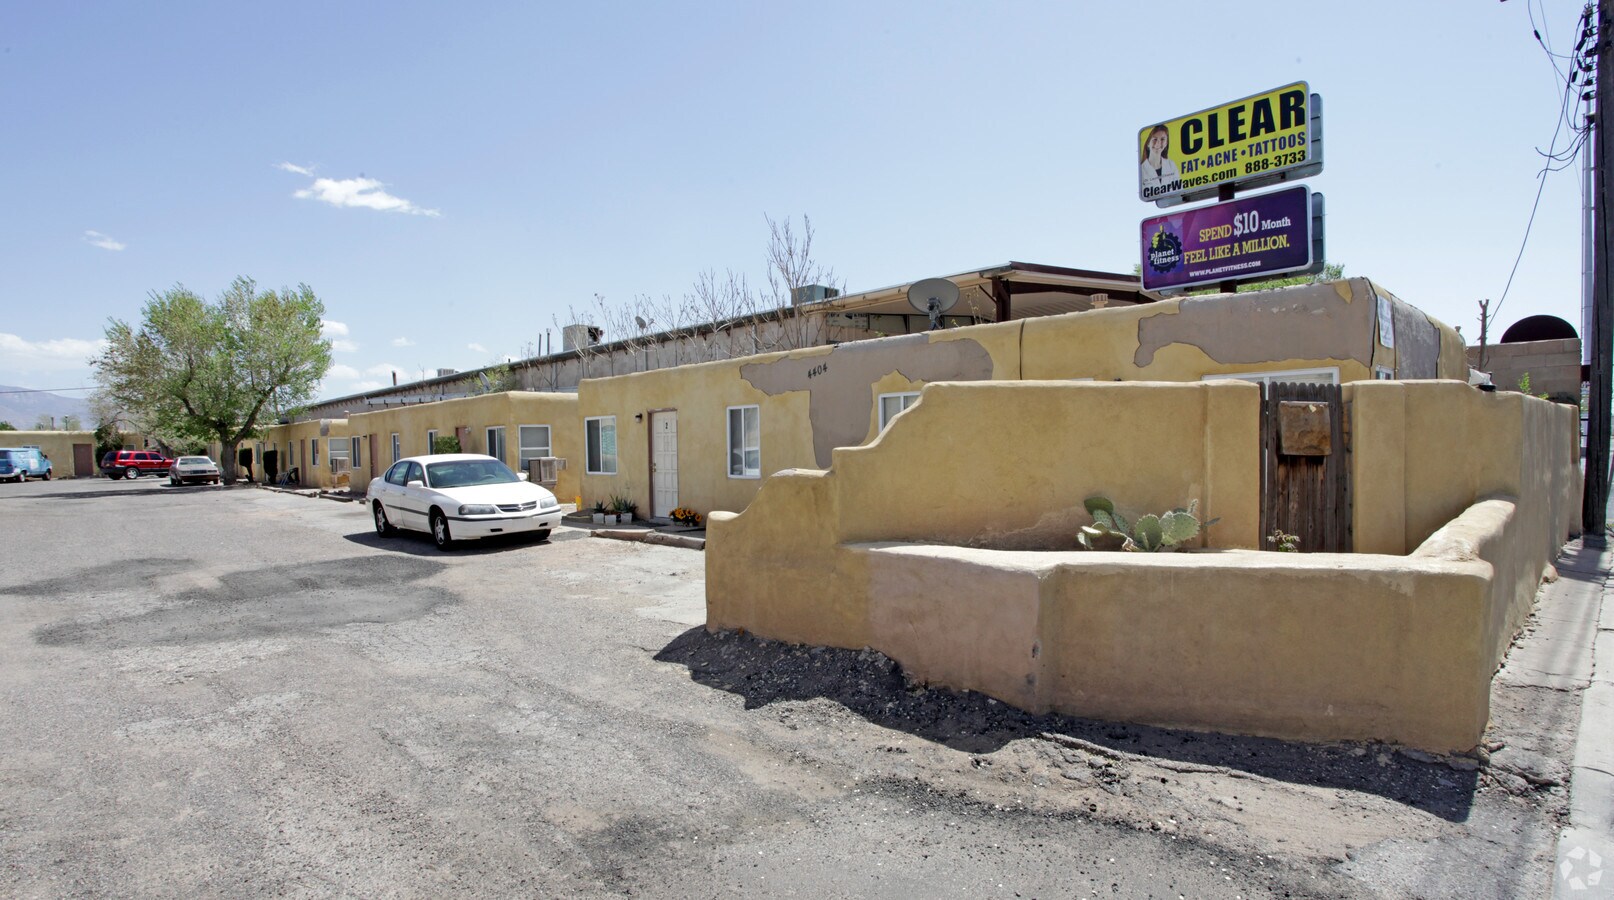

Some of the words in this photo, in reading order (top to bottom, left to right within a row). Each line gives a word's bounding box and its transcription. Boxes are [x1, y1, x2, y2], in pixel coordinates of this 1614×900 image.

[1180, 89, 1306, 156] CLEAR
[1143, 167, 1237, 198] ClearWaves.com
[1245, 150, 1306, 174] 888-3733
[1199, 224, 1232, 242] SPEND
[1233, 210, 1259, 237] $10
[1261, 216, 1291, 231] Month
[1150, 248, 1174, 261] planet
[1184, 249, 1207, 264] FEEL
[1209, 245, 1231, 260] LIKE
[1232, 244, 1240, 256] A
[1241, 234, 1290, 255] MILLION.
[1153, 255, 1179, 265] fitness
[1189, 260, 1261, 277] WWW.PLANETFITNESS.COM
[807, 362, 828, 379] 4404
[665, 422, 669, 430] 2
